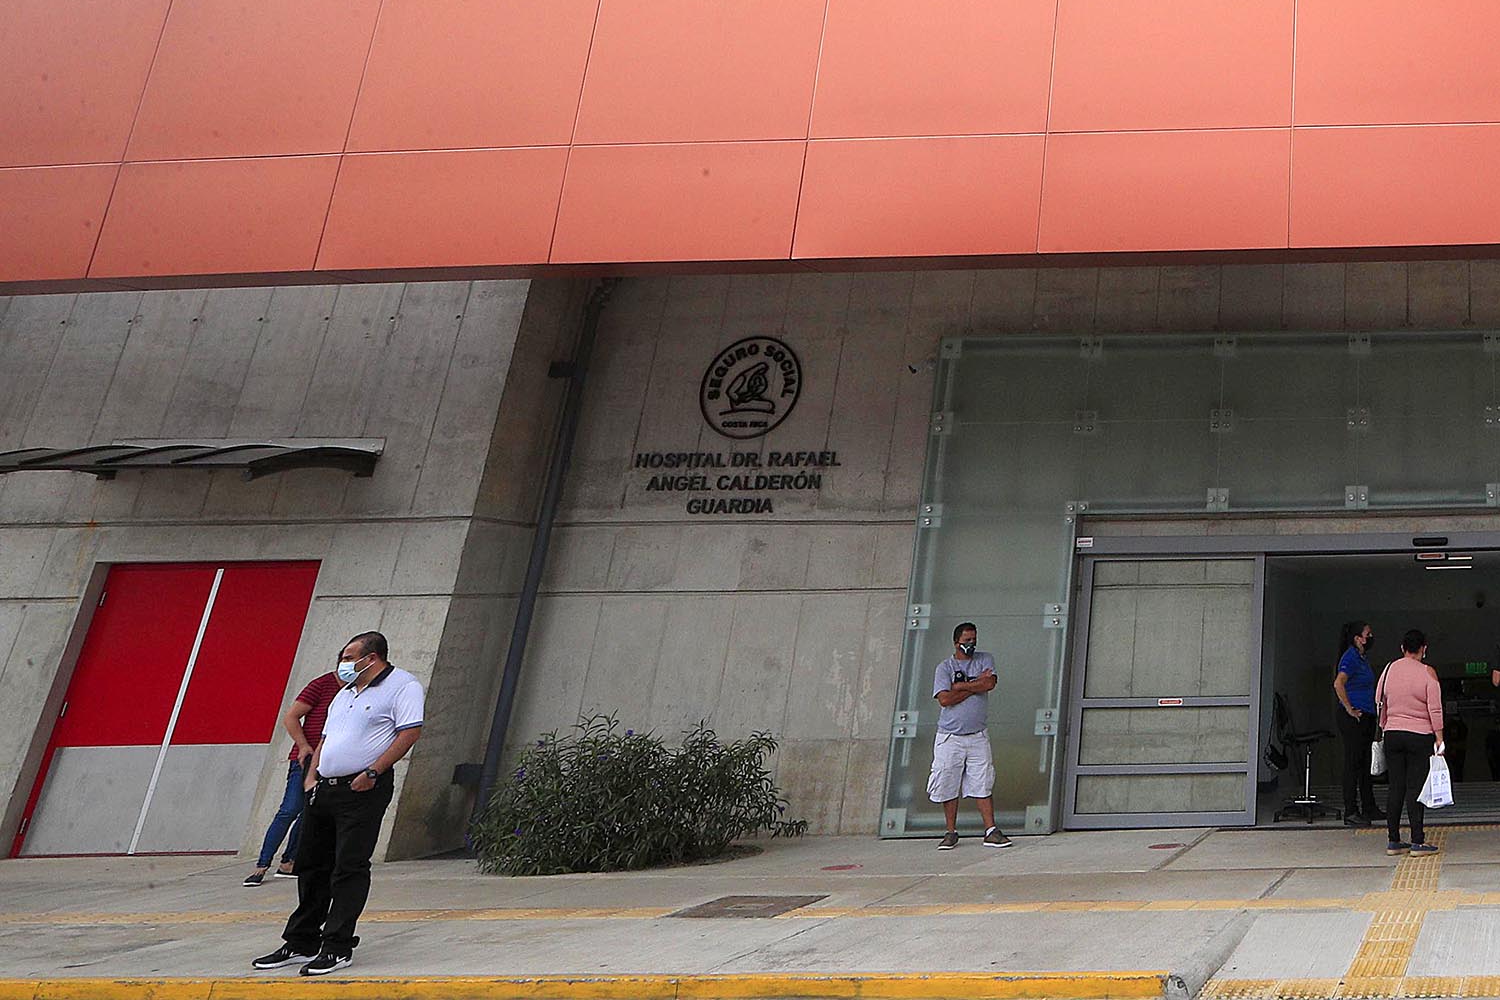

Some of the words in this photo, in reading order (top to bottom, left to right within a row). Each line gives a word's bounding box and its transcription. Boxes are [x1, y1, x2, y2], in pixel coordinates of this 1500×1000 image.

[708, 344, 759, 400] SEGURO
[764, 345, 796, 397] SOCIAL
[634, 452, 726, 468] HOSPITAL
[730, 452, 762, 468] DR.
[767, 451, 842, 467] RAFAEL
[646, 475, 712, 491] ANGEL
[716, 471, 822, 490] CALDERÓN
[686, 498, 774, 514] GUARDIA
